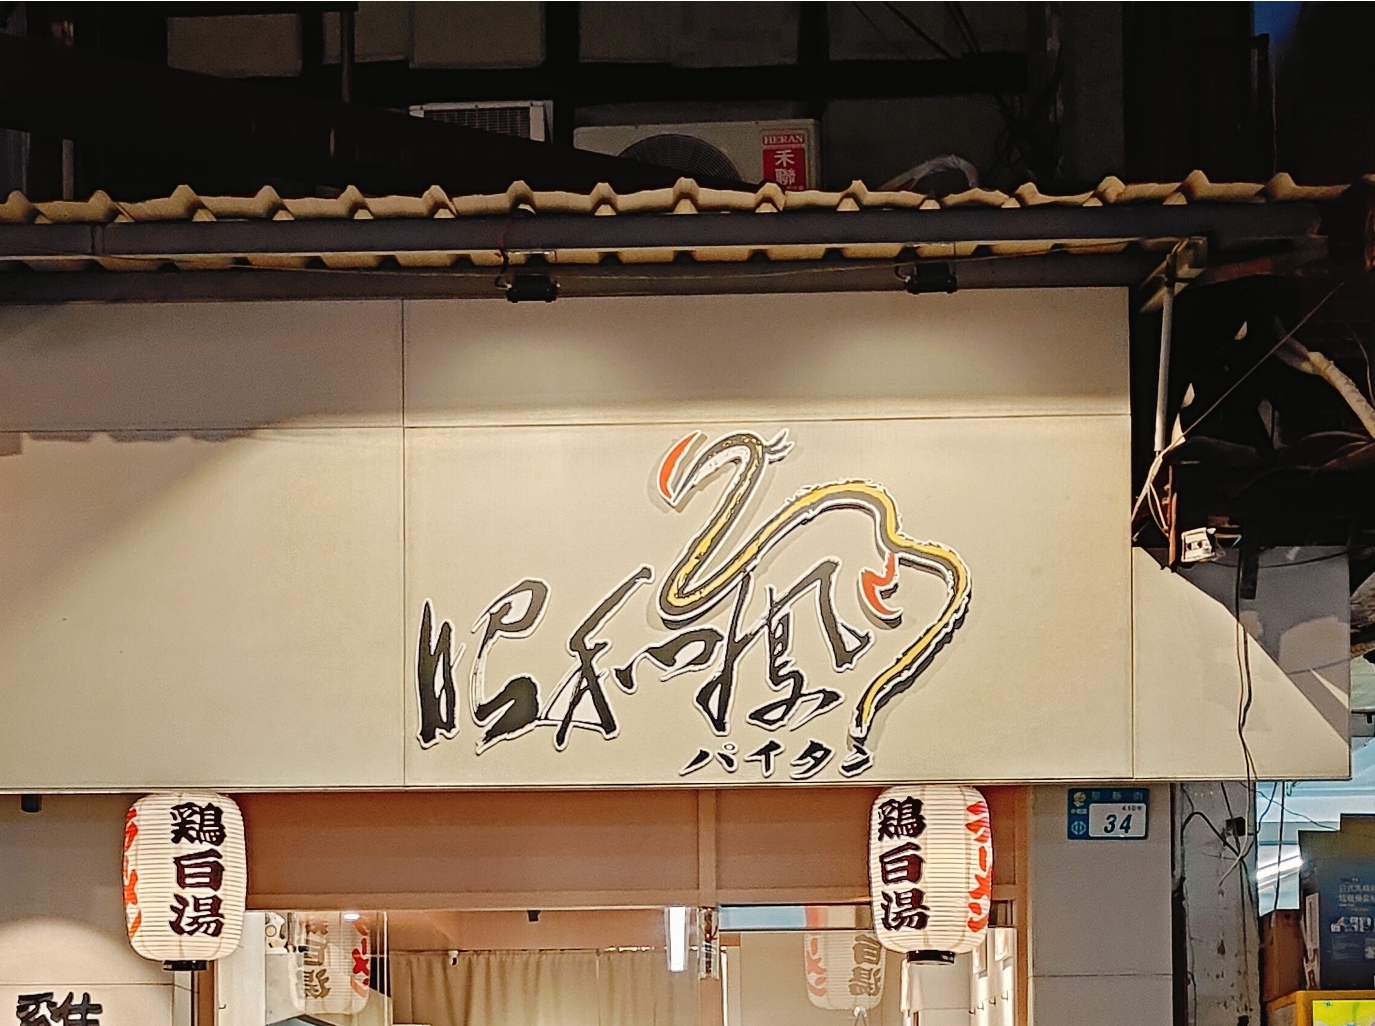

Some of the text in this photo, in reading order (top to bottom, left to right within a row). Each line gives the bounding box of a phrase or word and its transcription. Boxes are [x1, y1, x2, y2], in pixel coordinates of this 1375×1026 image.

[763, 134, 804, 144] HERAN
[679, 739, 874, 781] パイタン
[1103, 813, 1133, 834] 34
